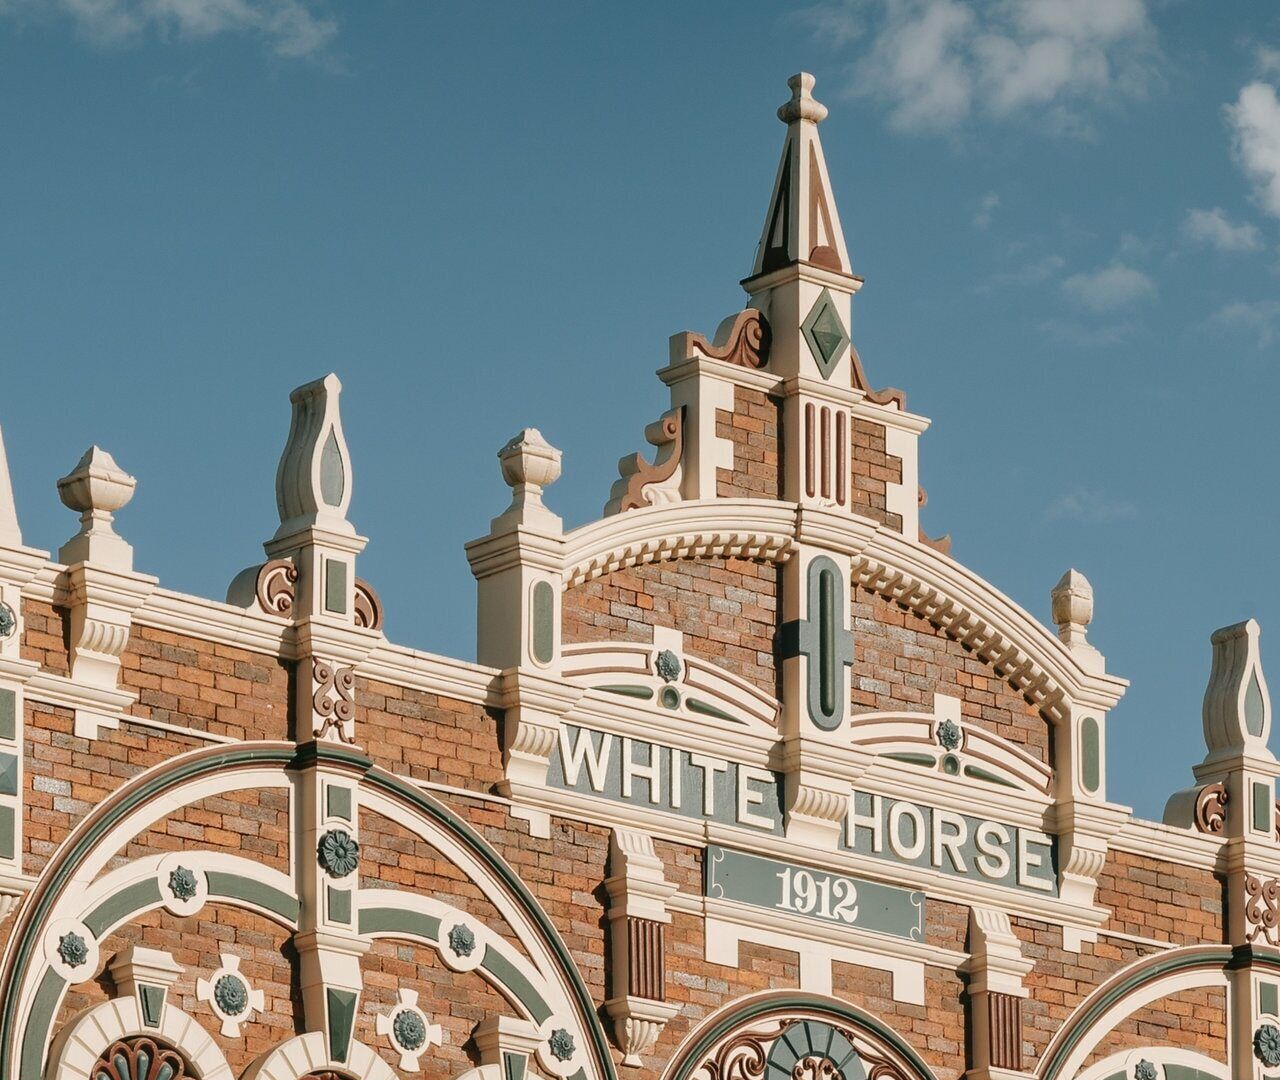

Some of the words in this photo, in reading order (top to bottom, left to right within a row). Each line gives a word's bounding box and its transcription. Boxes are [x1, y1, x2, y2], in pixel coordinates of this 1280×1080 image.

[558, 722, 776, 830] WHITE
[846, 794, 1053, 892] HORSE
[775, 866, 860, 924] 1912
